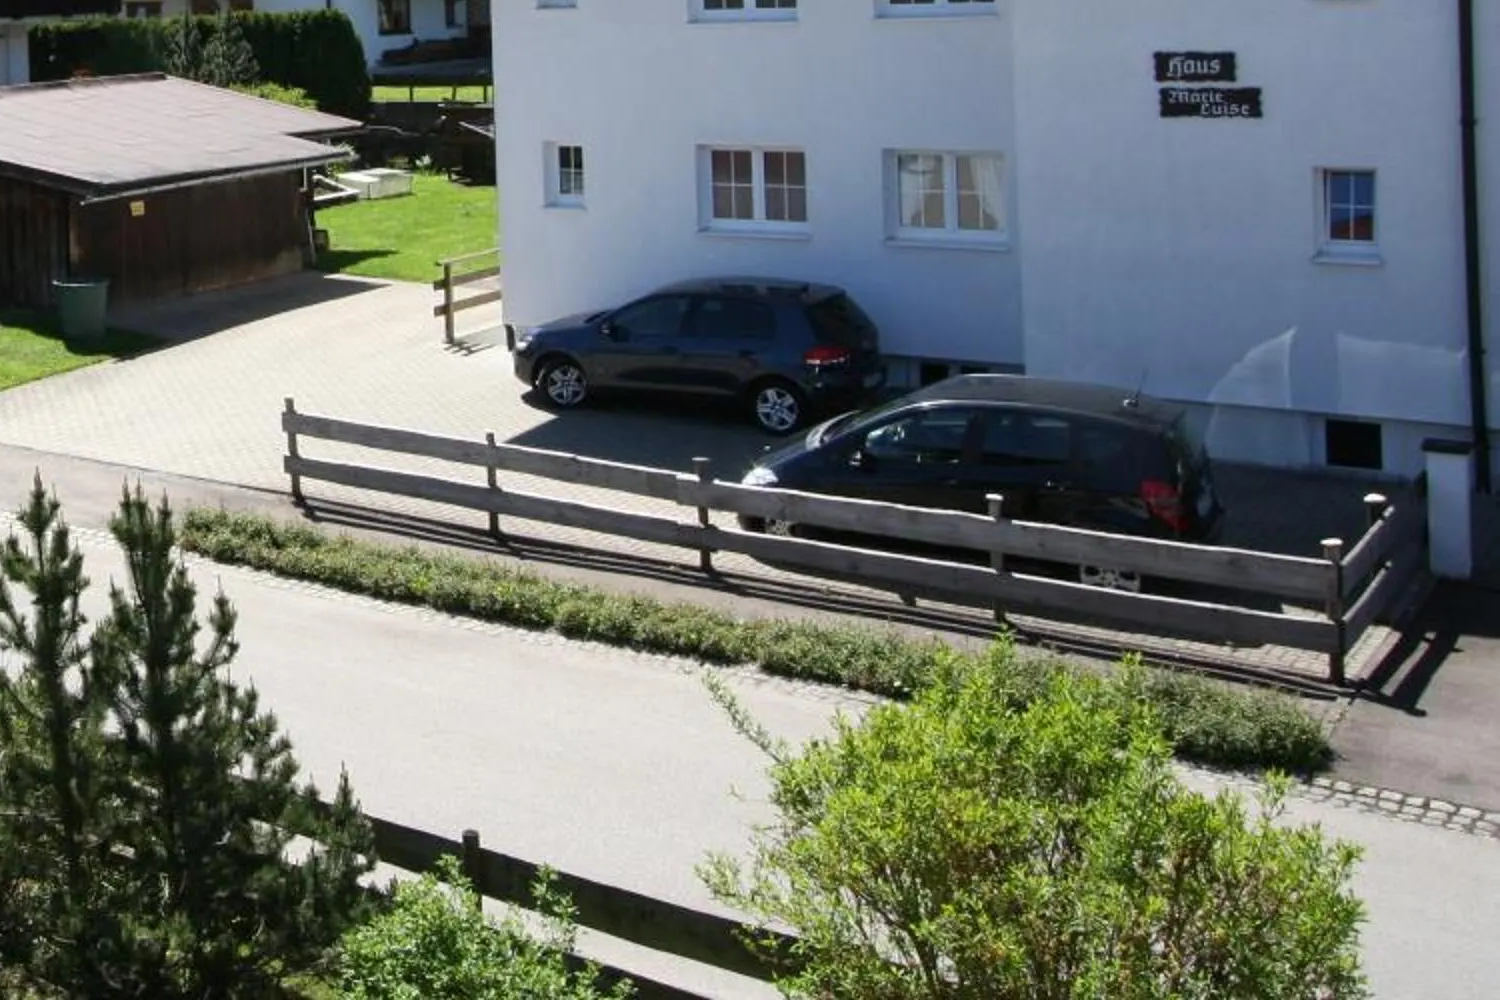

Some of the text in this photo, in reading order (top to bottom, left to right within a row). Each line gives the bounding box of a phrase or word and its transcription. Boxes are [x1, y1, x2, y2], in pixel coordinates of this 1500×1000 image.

[1166, 56, 1221, 78] Haus
[1168, 90, 1225, 104] Marie
[1201, 103, 1251, 115] Luise
